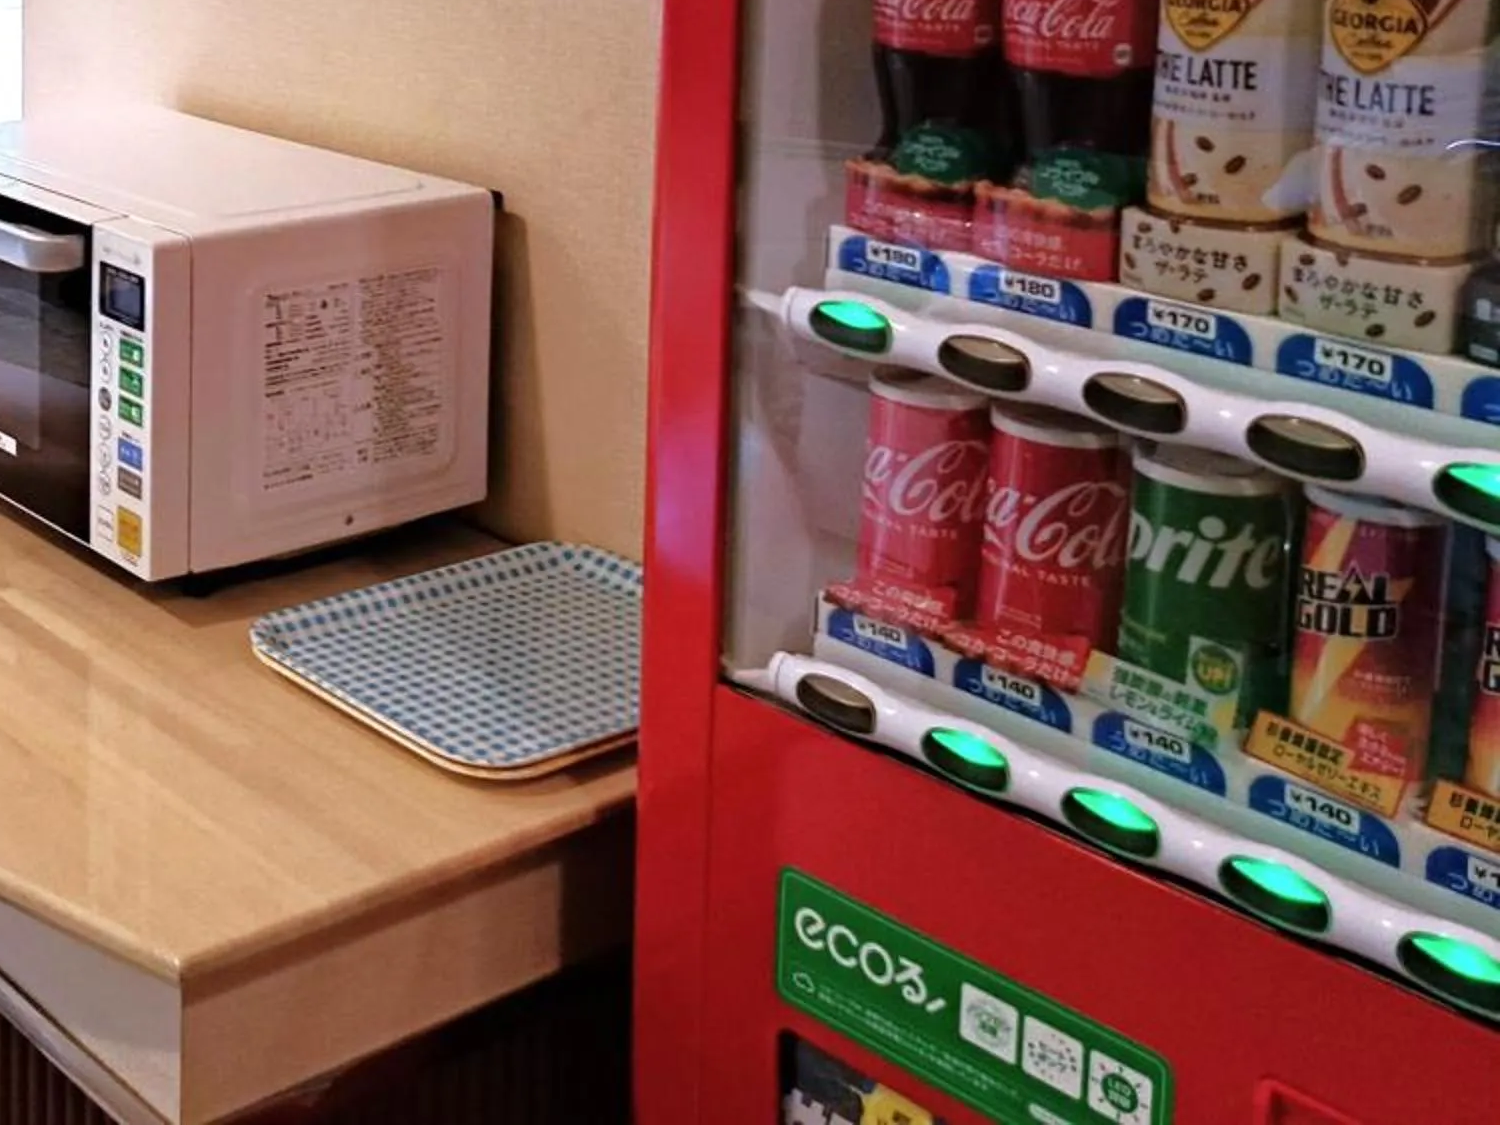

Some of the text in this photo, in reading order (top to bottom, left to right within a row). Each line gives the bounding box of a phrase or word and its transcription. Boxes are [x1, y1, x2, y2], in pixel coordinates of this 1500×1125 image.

[1333, 9, 1419, 36] GEORGIA
[1186, 56, 1258, 91] LATTE
[1354, 78, 1436, 117] LATTE
[1132, 233, 1249, 272] まろやかな甘さ
[1004, 277, 1056, 299] ¥180
[1292, 266, 1425, 310] まろやかな甘さ
[1152, 308, 1211, 335] ¥170
[1320, 344, 1385, 375] ¥170
[1130, 515, 1283, 590] prite
[1301, 560, 1392, 605] REAL
[1299, 603, 1397, 641] GOLD
[1290, 791, 1352, 826] ¥140
